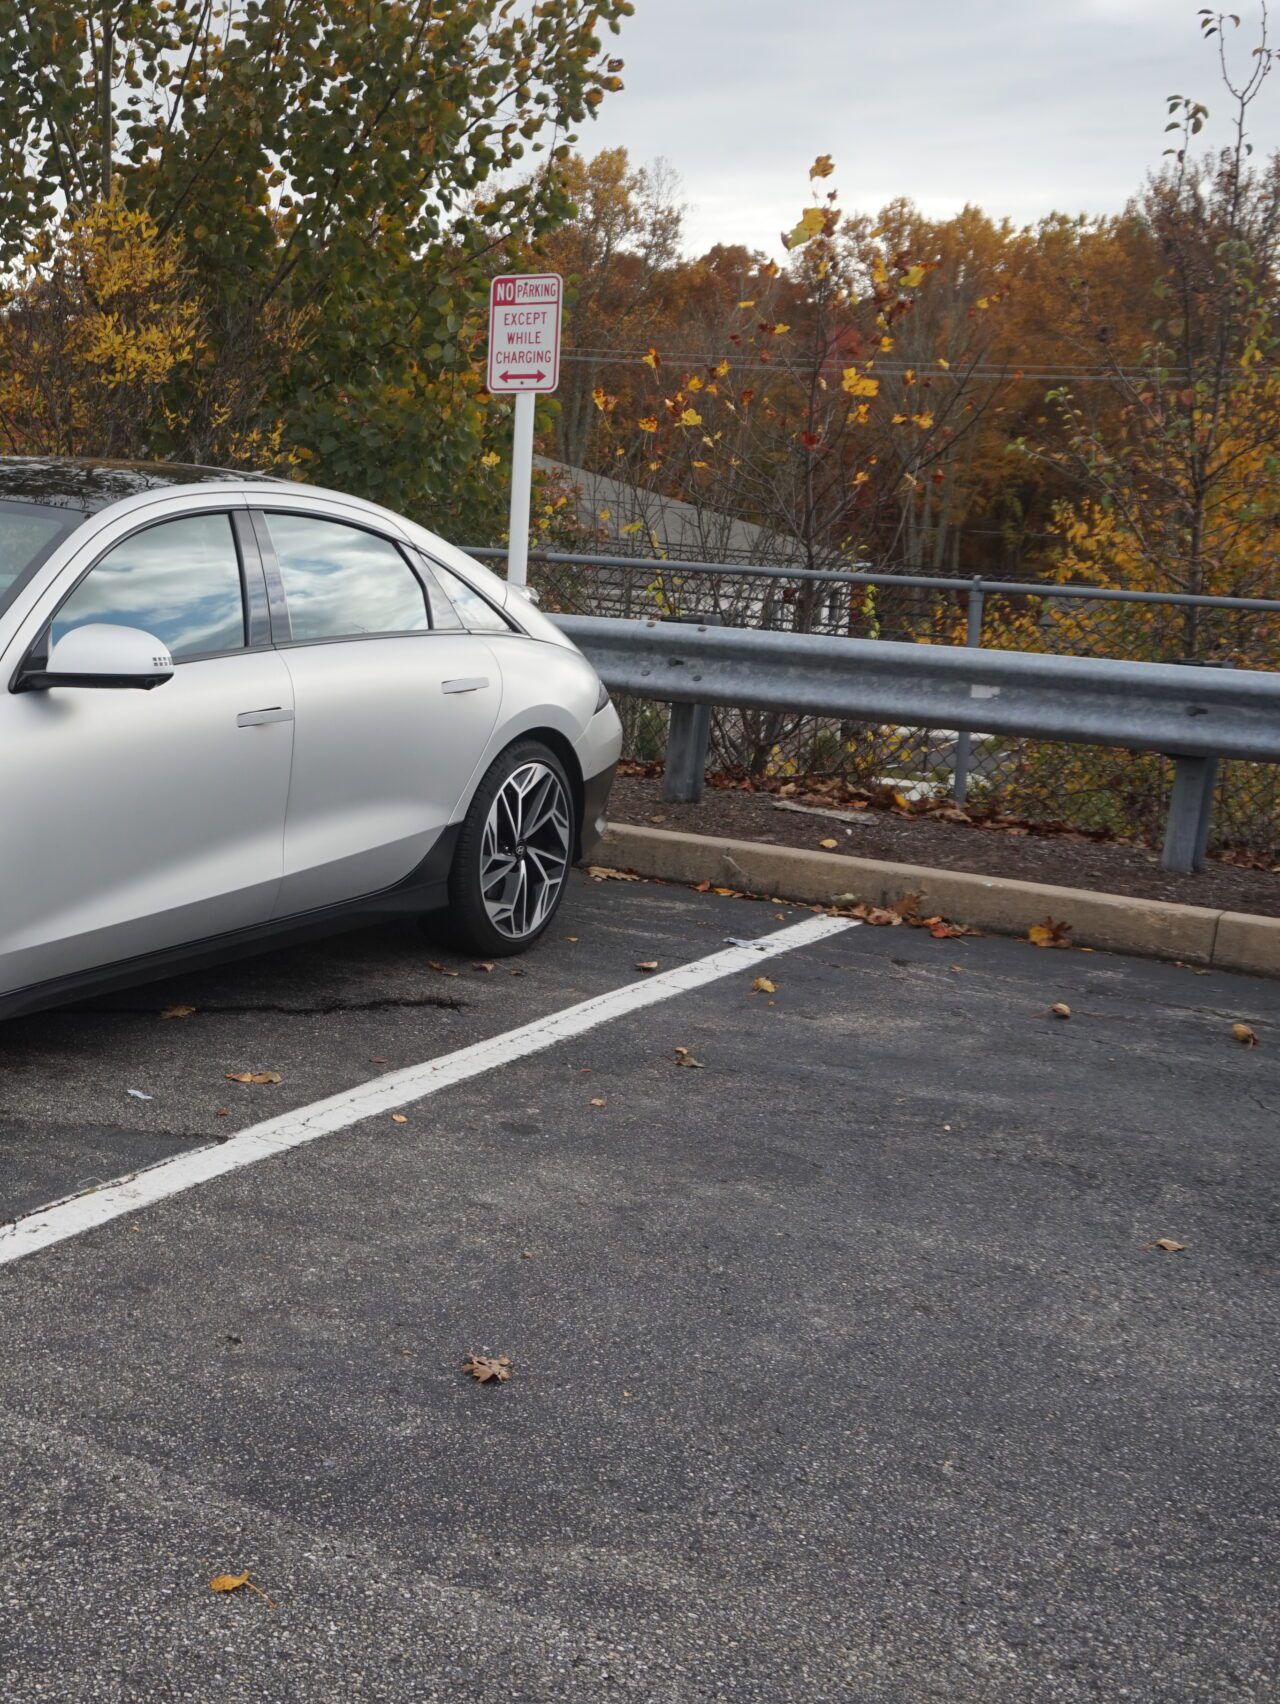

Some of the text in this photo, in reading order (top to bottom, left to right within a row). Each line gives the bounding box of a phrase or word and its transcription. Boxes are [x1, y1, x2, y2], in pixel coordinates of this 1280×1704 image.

[497, 283, 556, 301] NO PARKING
[504, 312, 547, 325] EXCEPT
[507, 332, 541, 344] WHILE
[496, 351, 551, 364] CHARGING
